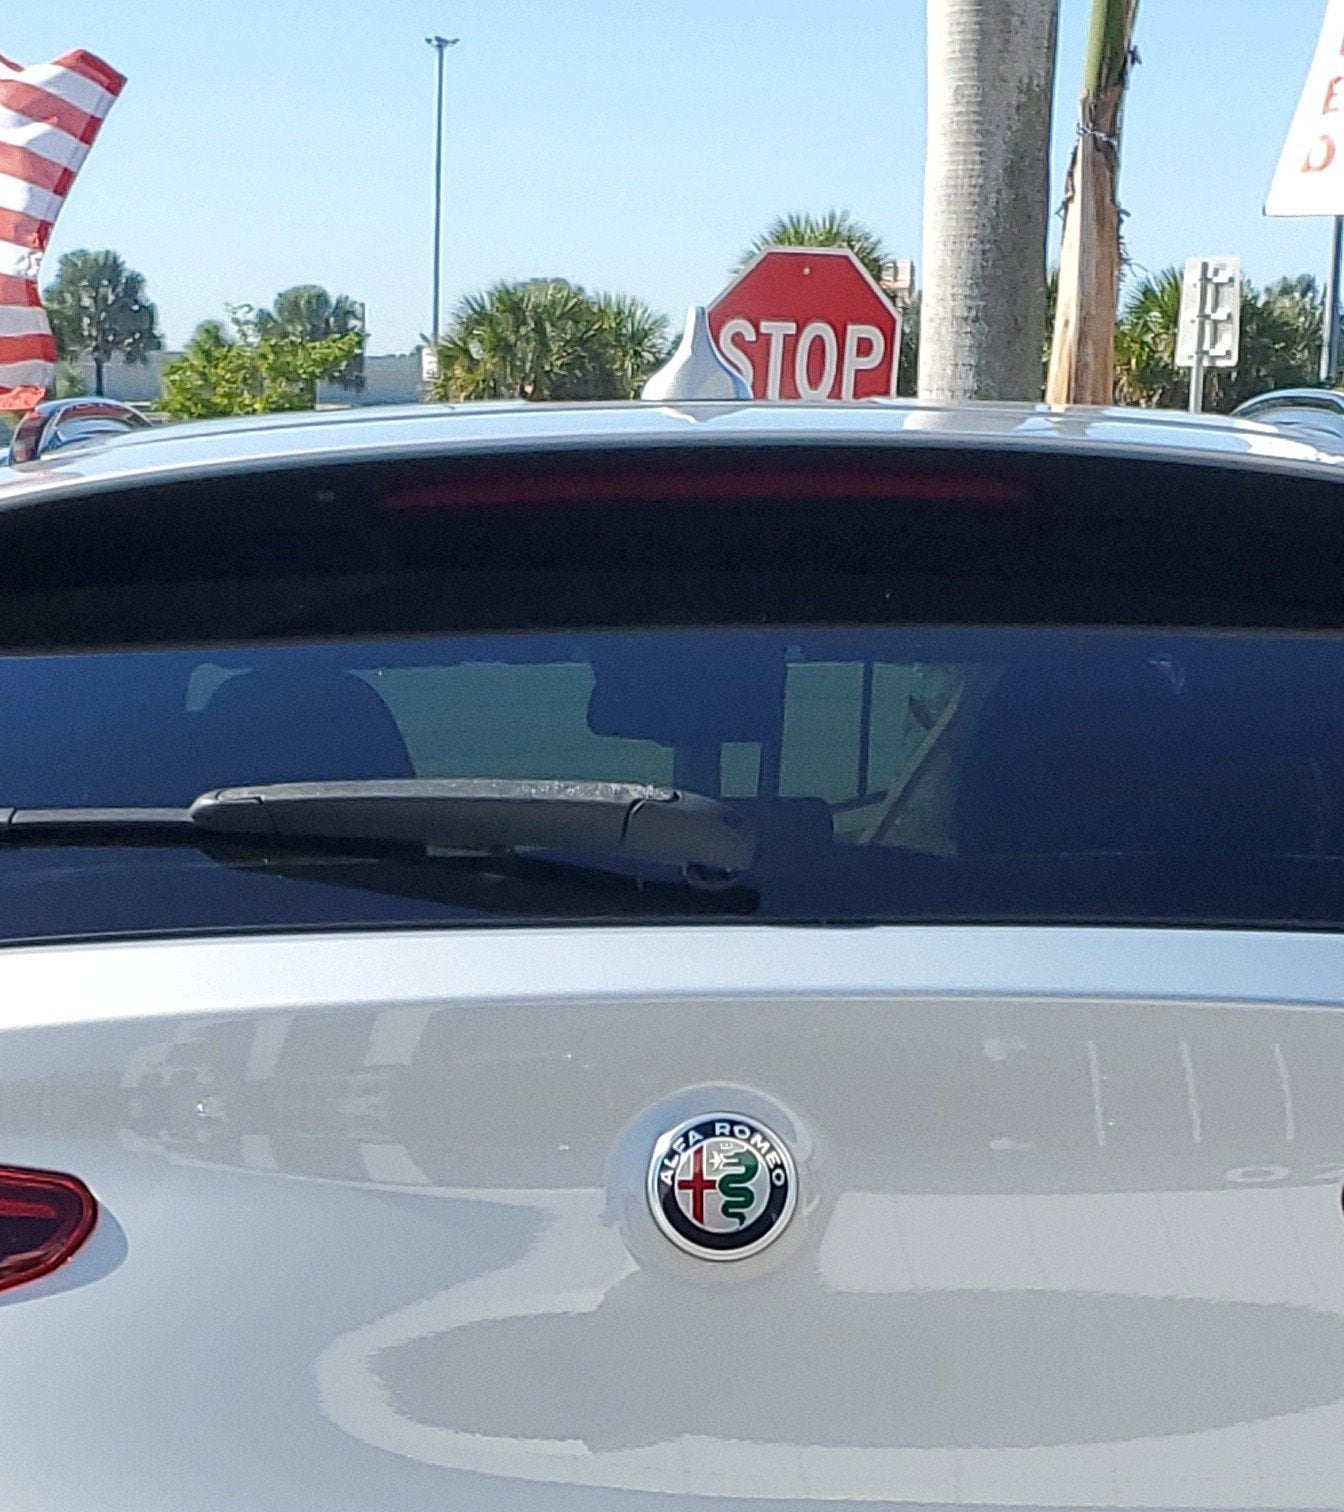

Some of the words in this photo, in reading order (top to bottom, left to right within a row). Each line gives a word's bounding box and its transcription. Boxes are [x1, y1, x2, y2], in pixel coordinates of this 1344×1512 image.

[718, 318, 886, 400] STOP
[659, 1129, 704, 1186] ALFA
[714, 1121, 786, 1187] ROMEO
